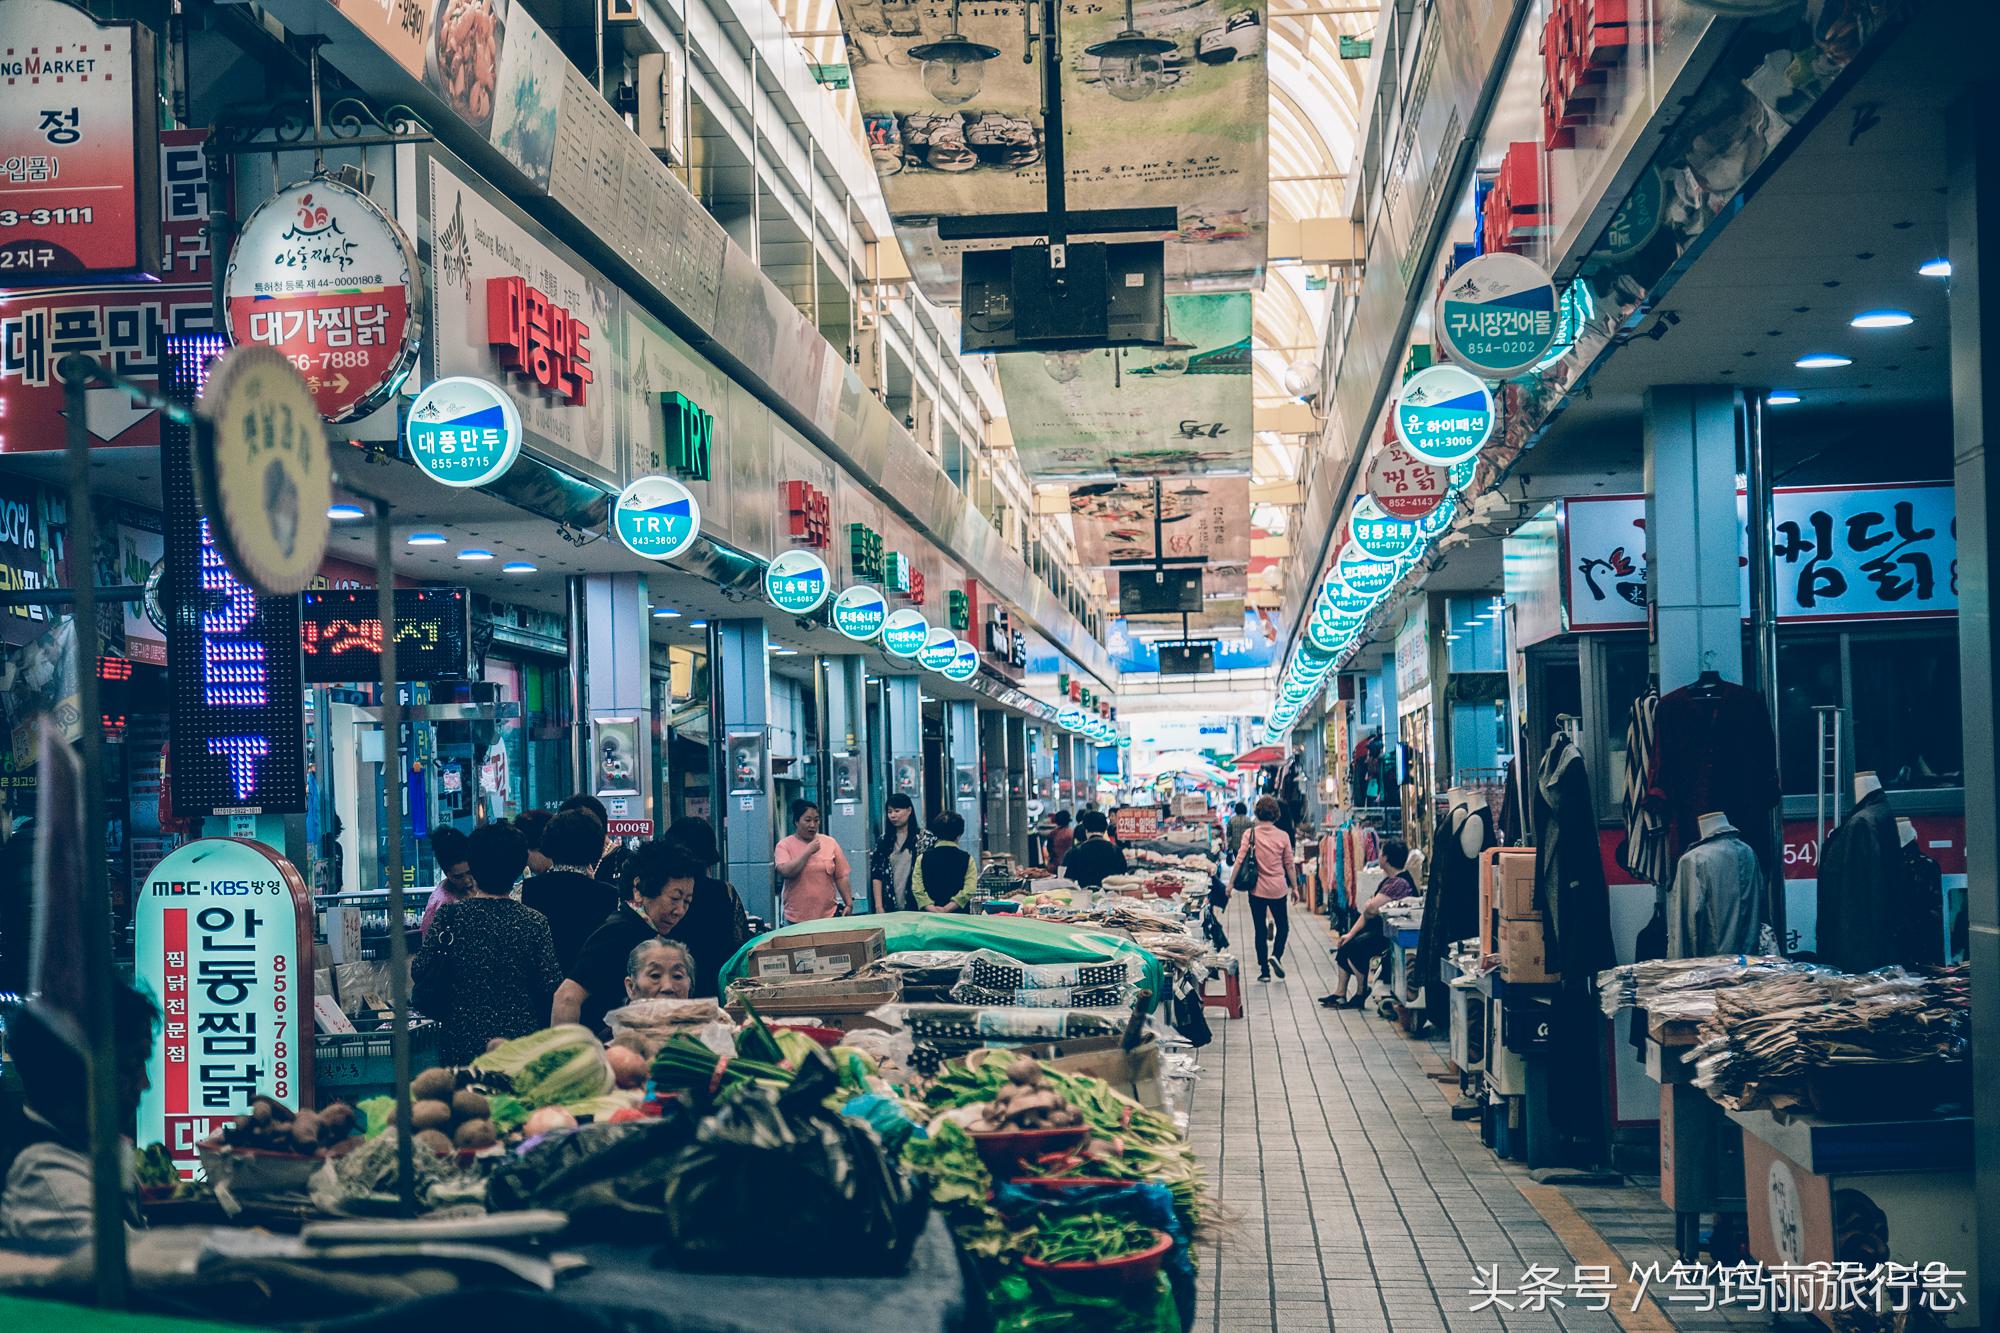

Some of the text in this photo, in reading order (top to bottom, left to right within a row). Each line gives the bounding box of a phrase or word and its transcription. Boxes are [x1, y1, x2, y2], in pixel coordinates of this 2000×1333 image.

[39, 107, 81, 145] 정
[275, 239, 359, 272] 안동찜닭
[254, 281, 284, 293] 특허청
[285, 280, 304, 291] 등록
[250, 304, 390, 348] 대가찜닭
[1451, 310, 1552, 337] 구시장건어물
[1468, 341, 1536, 354] 854-0202
[287, 350, 370, 372] 56-7888
[1404, 414, 1484, 435] 윤 하이패션
[418, 428, 500, 454] 대풍만두
[664, 391, 714, 481] TRY
[1420, 436, 1473, 448] 841-3006
[431, 456, 490, 469] 855-8715
[1388, 497, 1434, 507] 852-4143
[632, 516, 676, 533] TRY
[632, 535, 677, 545] 843-3600
[250, 880, 280, 896] 방영
[166, 951, 187, 1064] 찜닭전문점
[196, 907, 264, 1109] 안동찜닭
